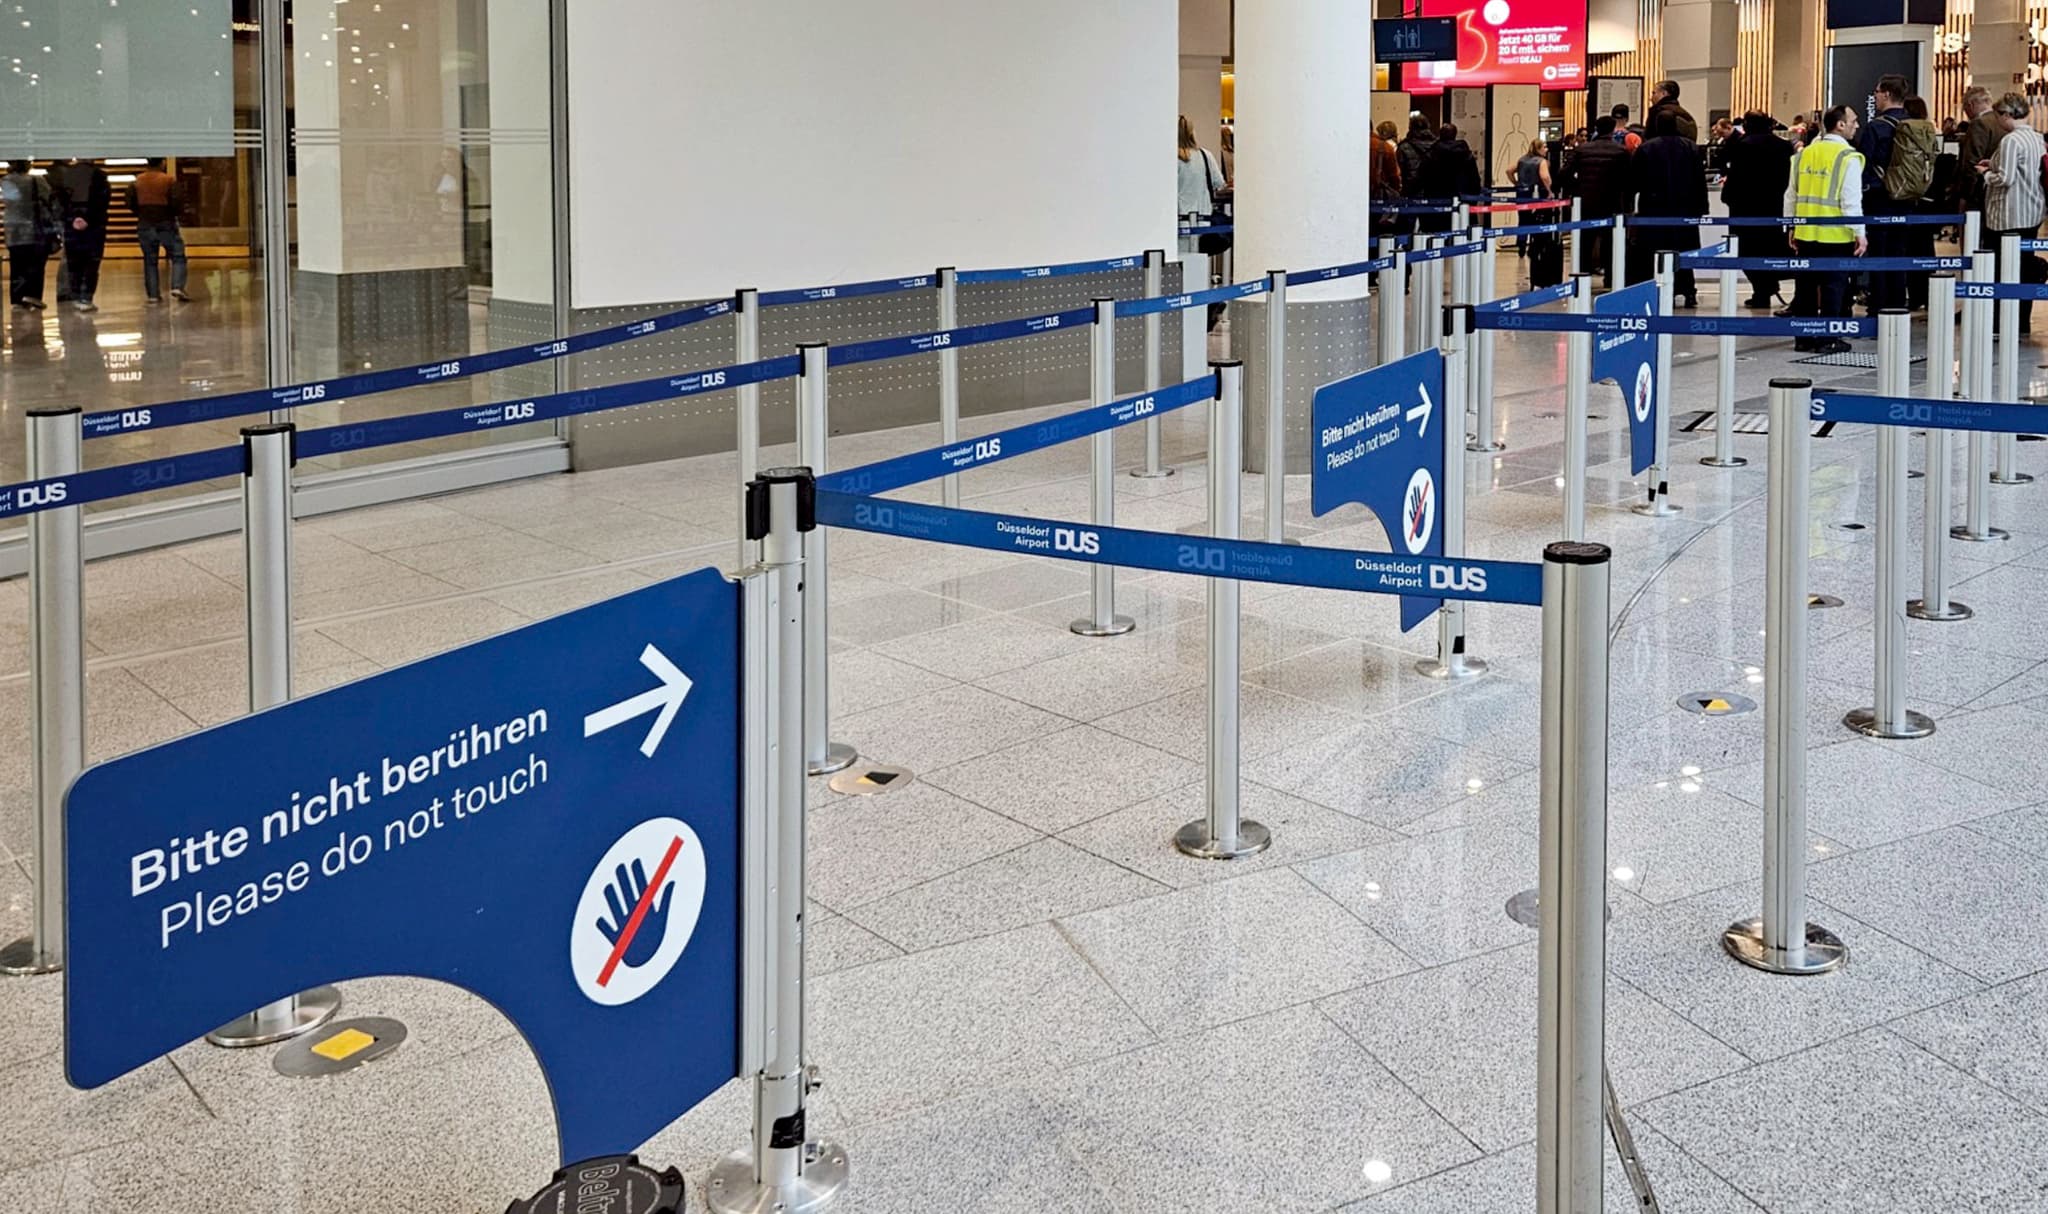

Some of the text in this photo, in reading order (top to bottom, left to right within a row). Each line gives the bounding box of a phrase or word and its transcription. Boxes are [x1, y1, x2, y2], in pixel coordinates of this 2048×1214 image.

[1790, 260, 1809, 268] DUS
[1940, 259, 1962, 268] DUS
[821, 288, 835, 297] DUS
[1968, 286, 1994, 296] DUS
[1045, 315, 1060, 328] DUS
[1621, 318, 1647, 330] DUS
[1830, 321, 1859, 333] DUS
[933, 333, 950, 346] DUS
[552, 341, 568, 354] DUS
[442, 362, 460, 376] DUS
[702, 372, 725, 387] DUS
[302, 384, 325, 400] DUS
[505, 402, 535, 421] DUS
[1135, 396, 1154, 416] DUS
[84, 414, 120, 426] Düsseldorf
[122, 410, 151, 428] DUS
[464, 408, 501, 419] Düsseldorf
[477, 416, 502, 425] Airport
[96, 423, 120, 432] Airport
[1322, 402, 1400, 448] Bitte nicht berühren
[942, 444, 974, 460] Düsseldorf
[976, 438, 1001, 460] DUS
[1327, 424, 1400, 471] Please do not touch
[953, 455, 974, 466] Airport
[18, 482, 67, 508] DUS
[997, 521, 1050, 537] Düsseldorf
[1015, 536, 1050, 549] Airport
[1055, 528, 1100, 554] DUS
[1355, 558, 1422, 574] Düsseldorf
[1379, 574, 1422, 588] Airport
[1429, 564, 1487, 592] DUS
[131, 706, 548, 897] Bitte nicht berühren
[162, 754, 548, 949] Please do not touch
